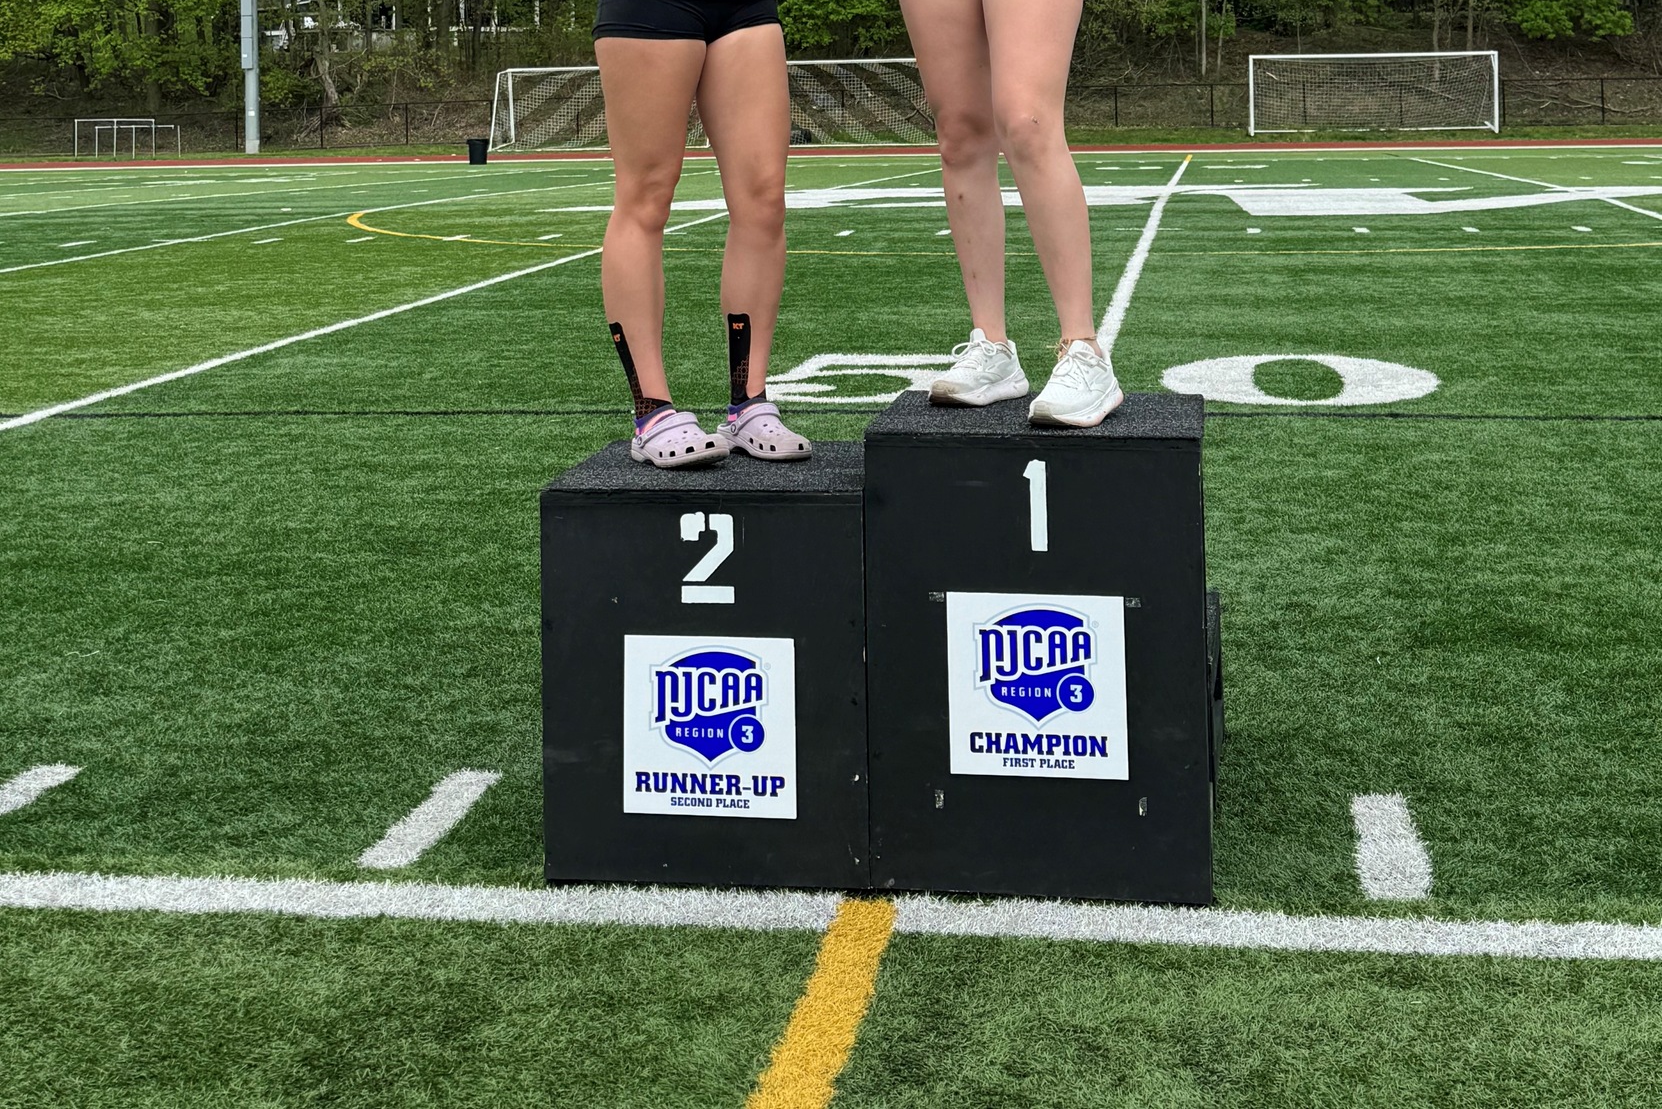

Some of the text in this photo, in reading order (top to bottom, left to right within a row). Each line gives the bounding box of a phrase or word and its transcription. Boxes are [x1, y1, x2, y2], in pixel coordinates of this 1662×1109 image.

[1022, 459, 1048, 552] 1
[680, 511, 735, 604] 2
[978, 628, 1092, 683] NJCAA
[655, 670, 763, 724] NJCAA
[1001, 684, 1083, 703] REGION 3
[675, 725, 754, 744] REGION 3
[969, 731, 1109, 758] CHAMPION
[1002, 757, 1075, 770] FIRST PLACE
[635, 771, 786, 798] RUNNER-UP
[670, 796, 750, 810] SECOND PLACE
